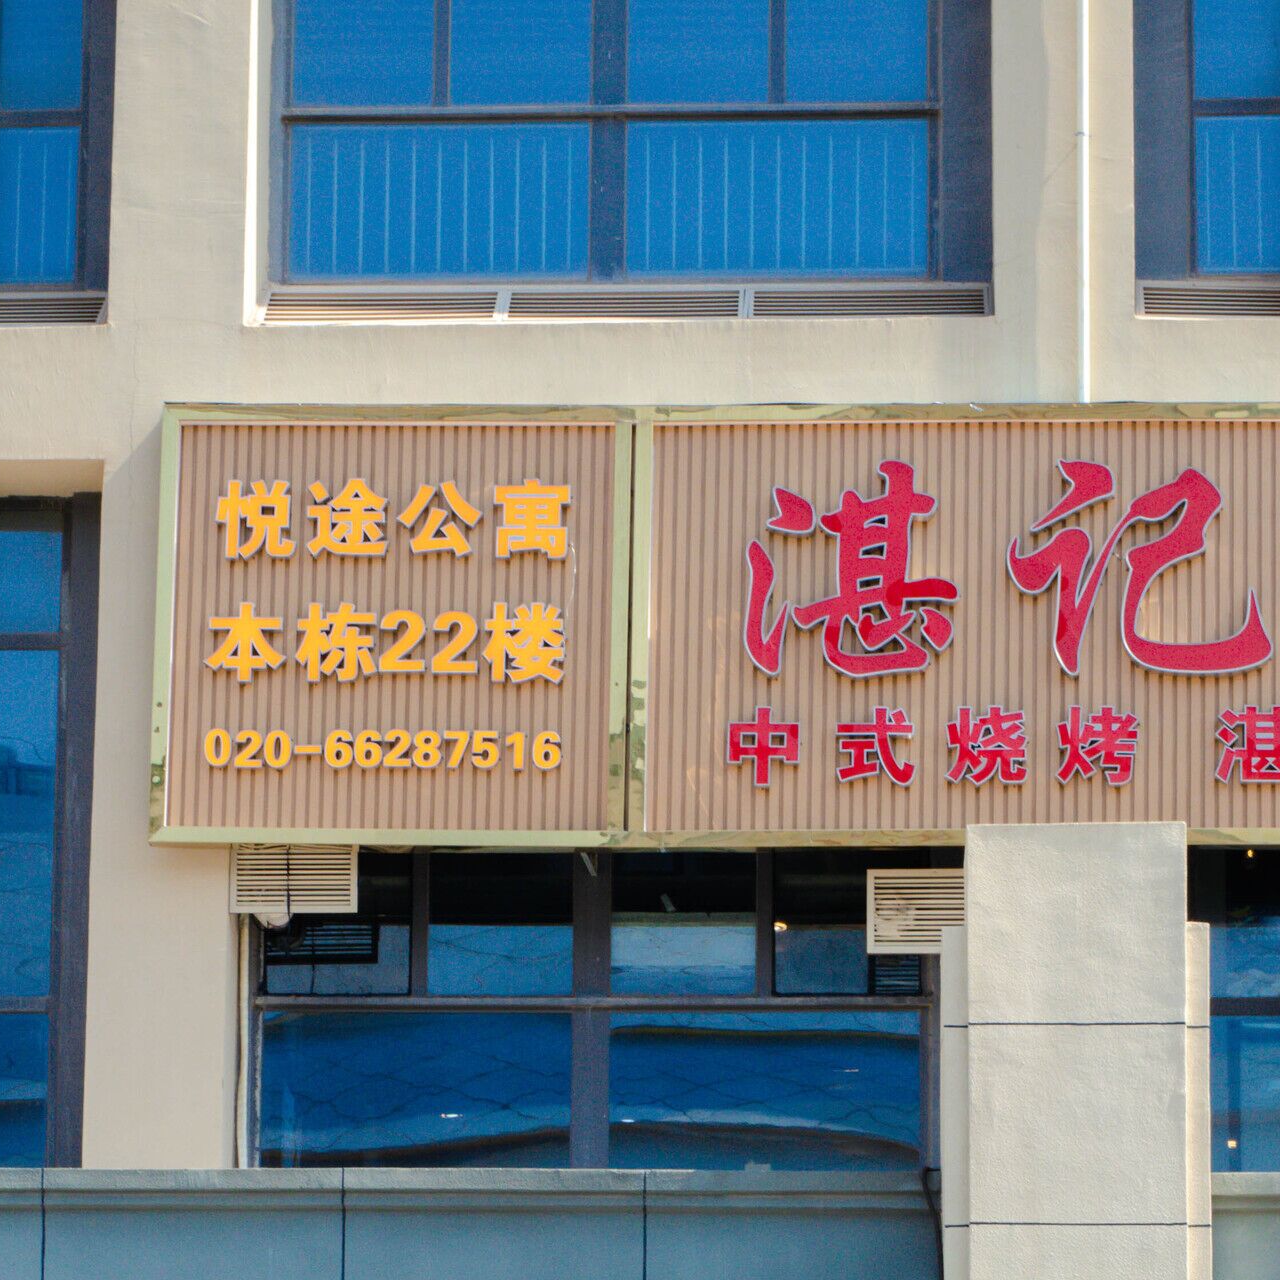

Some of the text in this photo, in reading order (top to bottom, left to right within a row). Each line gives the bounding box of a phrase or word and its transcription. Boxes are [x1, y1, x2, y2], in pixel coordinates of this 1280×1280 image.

[216, 478, 572, 560] 悦途公寓
[204, 602, 566, 685] 本栋22楼
[204, 728, 563, 770] 020-66287516
[728, 706, 1141, 787] 中式烧烤
